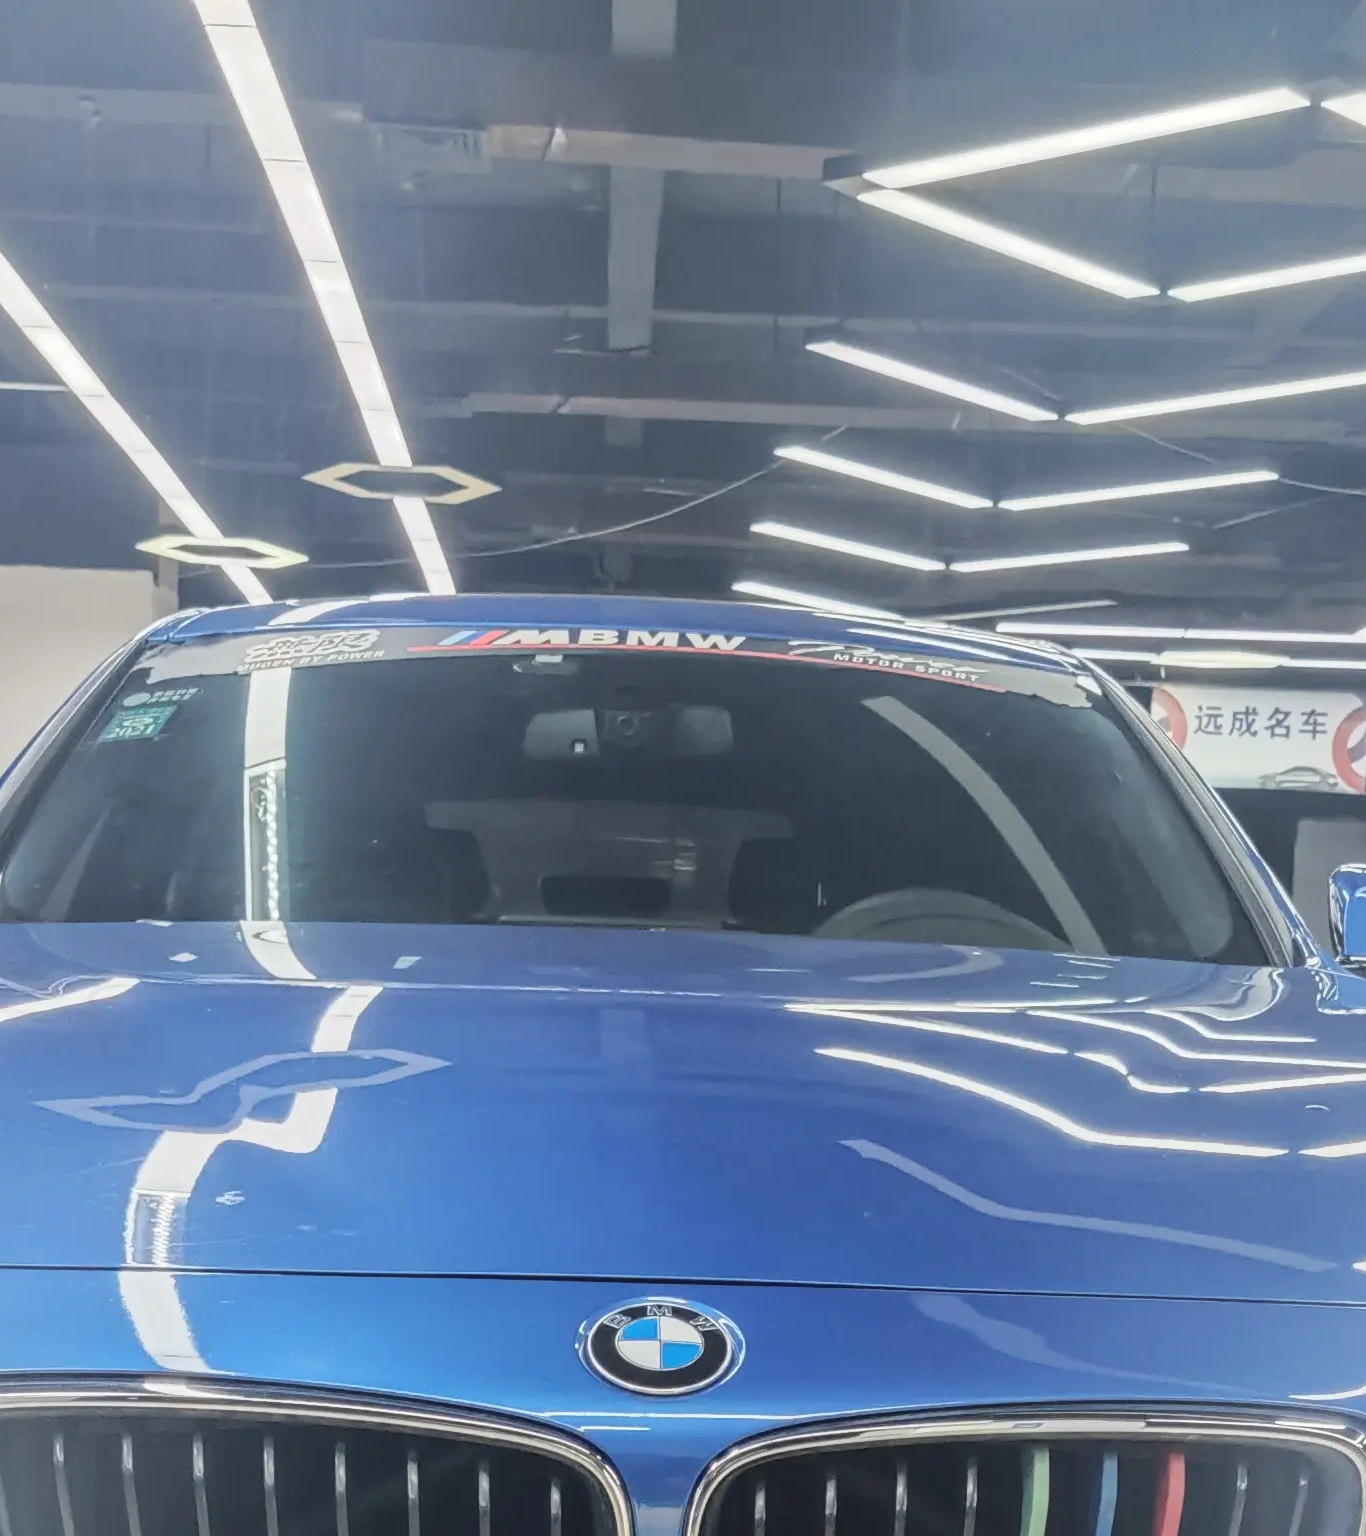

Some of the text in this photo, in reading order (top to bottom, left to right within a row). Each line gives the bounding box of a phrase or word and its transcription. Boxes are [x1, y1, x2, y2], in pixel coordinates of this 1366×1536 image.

[299, 654, 321, 666] BY
[333, 649, 385, 663] POWER
[832, 652, 905, 669] MOTOR
[914, 664, 980, 682] SPORT
[1192, 704, 1329, 741] 远成名车
[602, 1304, 719, 1332] BMW
